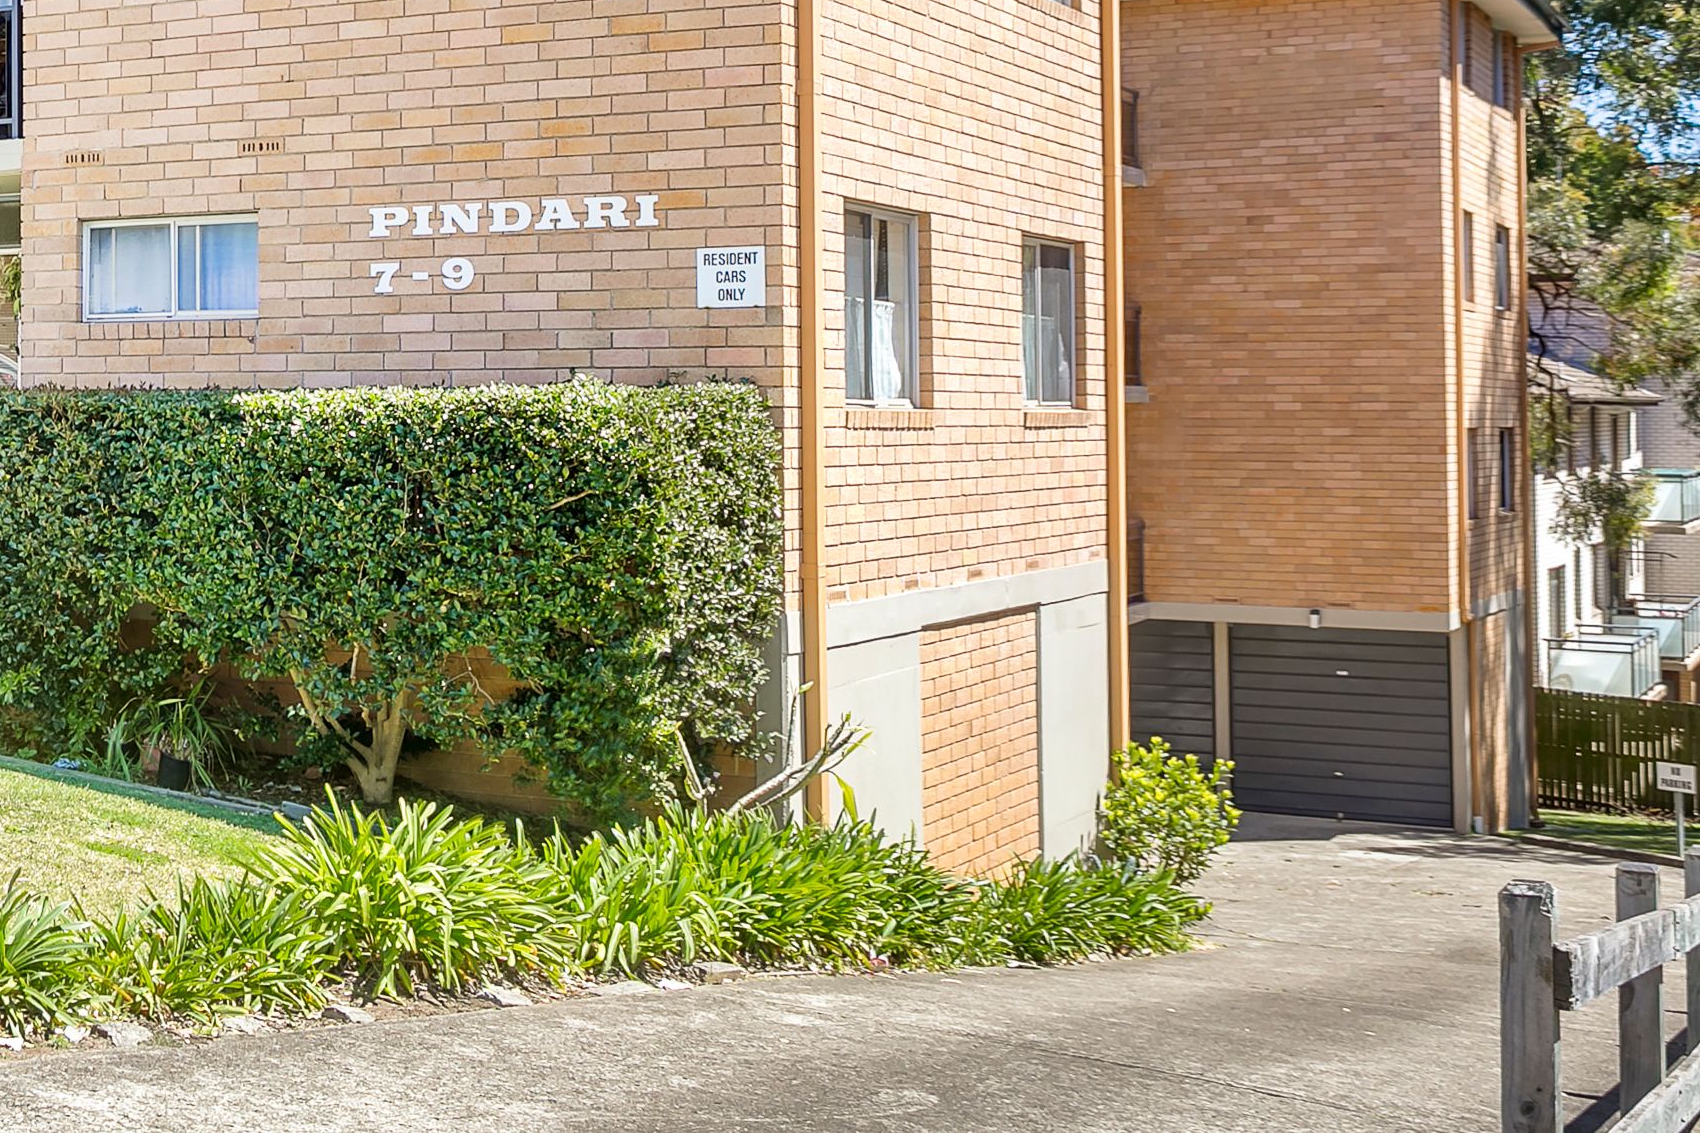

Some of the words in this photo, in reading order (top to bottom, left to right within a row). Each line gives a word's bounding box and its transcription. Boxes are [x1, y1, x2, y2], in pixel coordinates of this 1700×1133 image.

[368, 194, 660, 238] PINDARI
[703, 251, 758, 266] RESIDENT
[716, 270, 747, 284] CARS
[718, 288, 746, 301] ONLY
